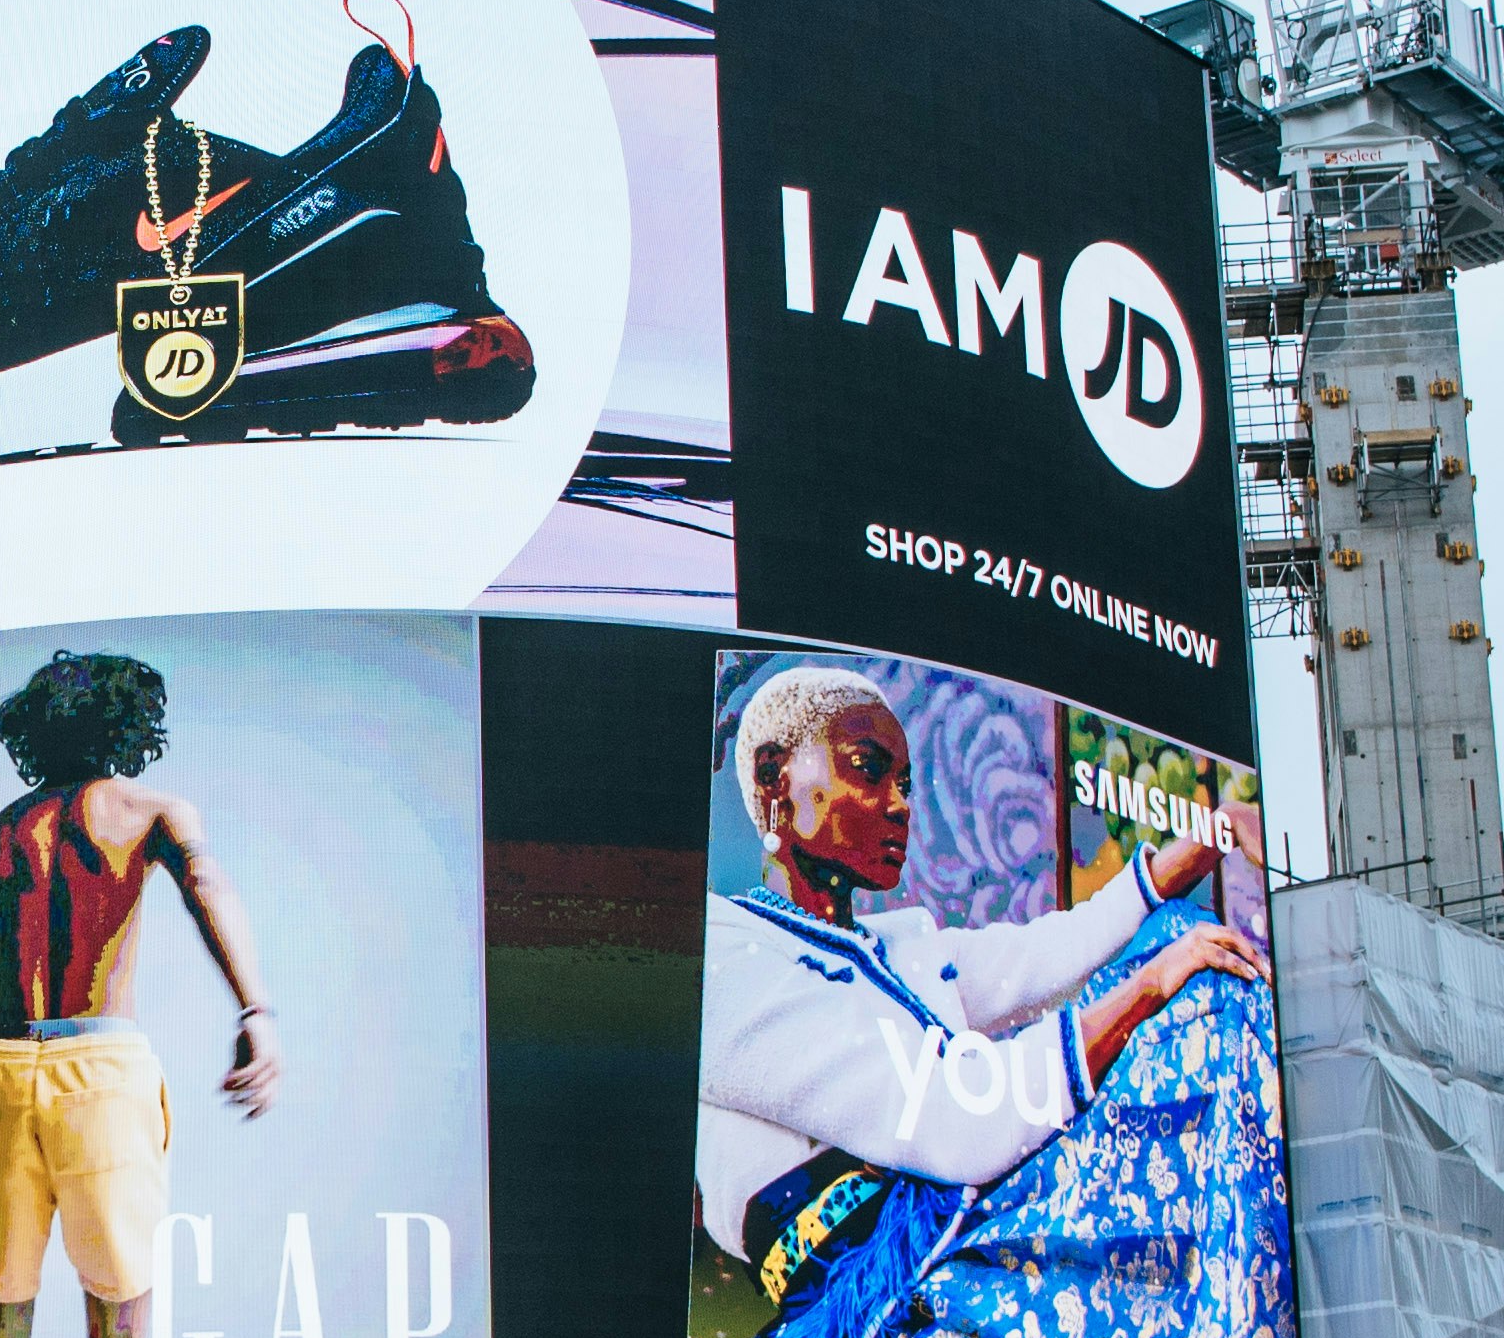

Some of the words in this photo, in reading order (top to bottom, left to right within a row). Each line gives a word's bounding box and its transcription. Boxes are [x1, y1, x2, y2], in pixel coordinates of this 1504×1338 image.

[1339, 148, 1383, 163] Select
[132, 308, 201, 331] ONLY
[202, 306, 228, 326] AT
[781, 185, 814, 314] I
[842, 206, 1047, 380] AM
[1083, 295, 1183, 430] JD
[155, 348, 205, 381] JD
[864, 522, 966, 575] SHOP
[972, 548, 1043, 599] 24/7
[1050, 574, 1151, 644] ONLINE
[1153, 614, 1220, 669] NOW
[1073, 759, 1235, 855] SAMSUNG
[877, 1016, 1064, 1142] you
